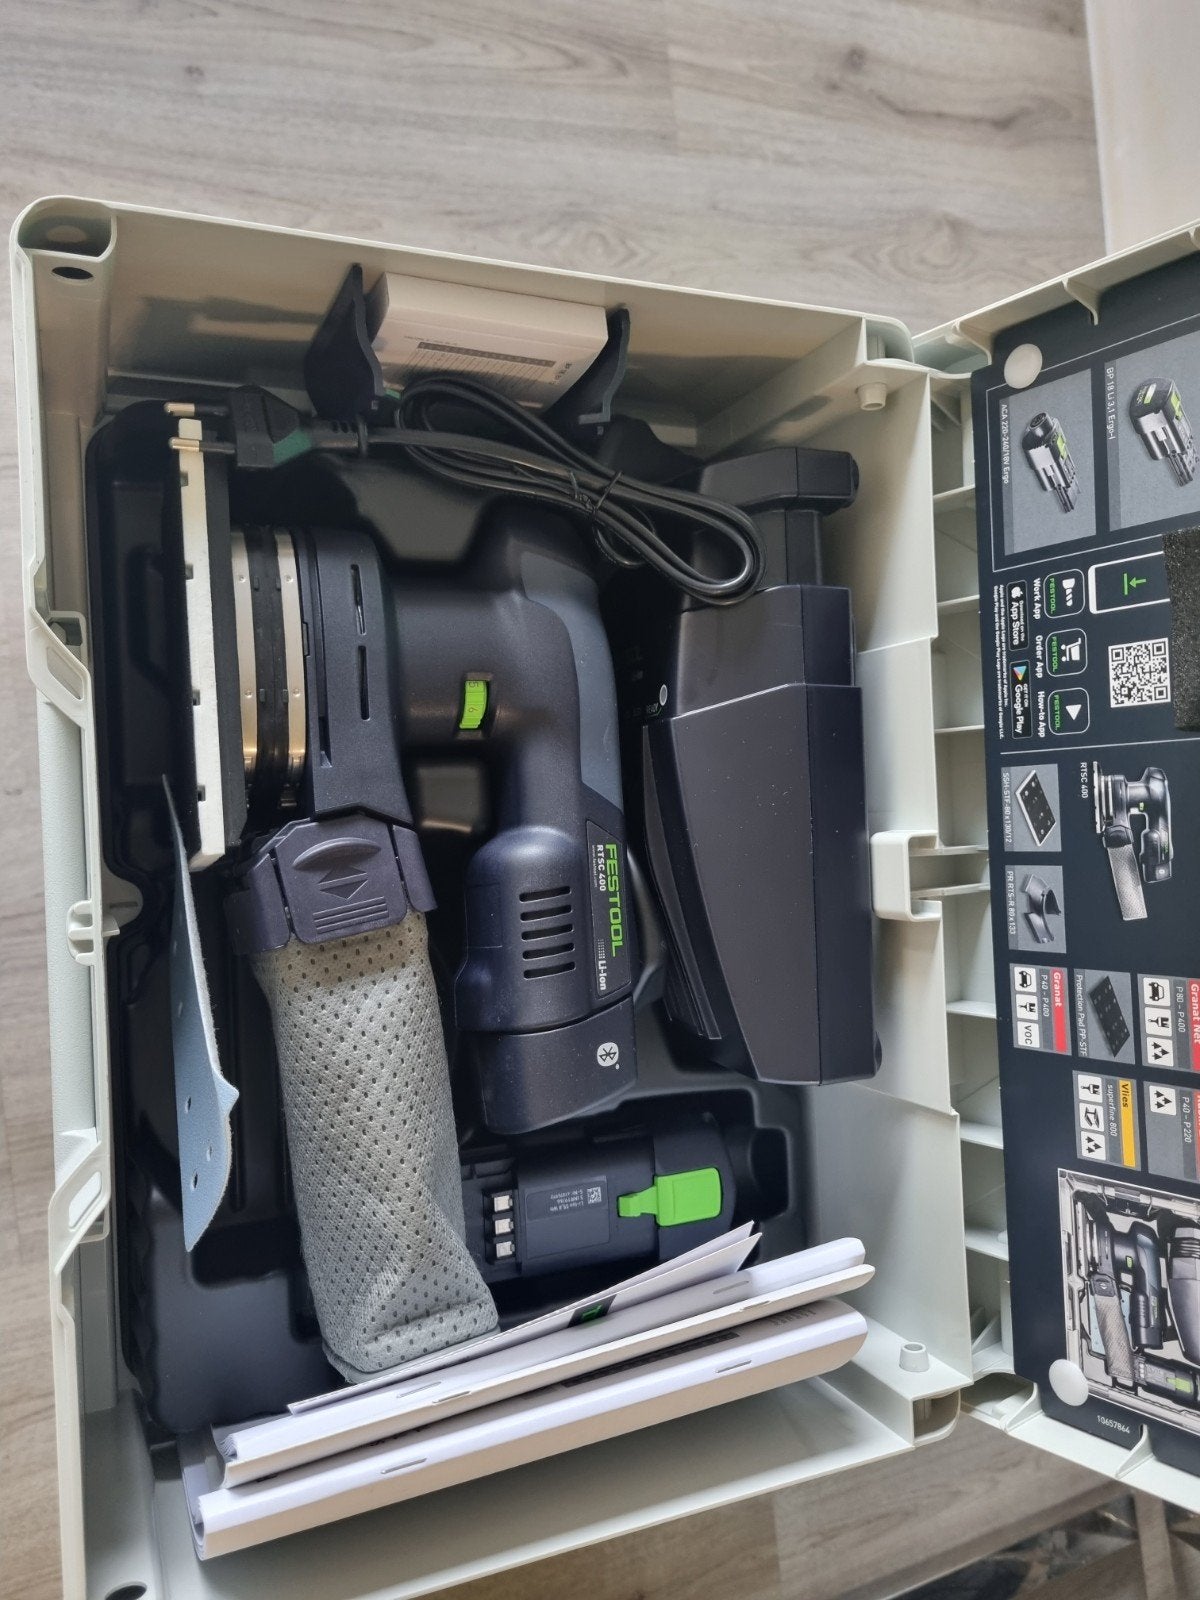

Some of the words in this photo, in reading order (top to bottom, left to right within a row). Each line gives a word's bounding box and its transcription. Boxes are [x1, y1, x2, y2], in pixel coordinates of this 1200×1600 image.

[1107, 367, 1114, 379] BP
[1107, 382, 1114, 391] 18
[1107, 402, 1115, 413] 3,1
[1033, 578, 1041, 601] Work
[1010, 602, 1019, 620] App
[1033, 601, 1042, 619] App
[1012, 621, 1020, 645] Store
[1035, 635, 1043, 660] Order
[1034, 662, 1044, 678] App
[1014, 684, 1023, 715] Google
[1038, 691, 1046, 720] How-to
[1015, 716, 1024, 734] Play
[1037, 721, 1046, 738] App
[597, 845, 605, 871] RTSC
[598, 872, 606, 891] 400
[1007, 871, 1014, 882] PR
[605, 844, 623, 957] FESTOOL
[598, 960, 607, 990] Li-Ion
[1054, 972, 1062, 1007] Granat
[1076, 974, 1084, 1011] Protection
[1190, 984, 1200, 1023] Granat
[1078, 1013, 1086, 1027] Pad
[1024, 1025, 1032, 1045] VOC
[1079, 1028, 1087, 1056] PP-STF
[1107, 1084, 1116, 1120] superfine
[1121, 1083, 1130, 1108] Vlies
[1109, 1122, 1117, 1136] 800
[1097, 1415, 1130, 1434] 10657864
